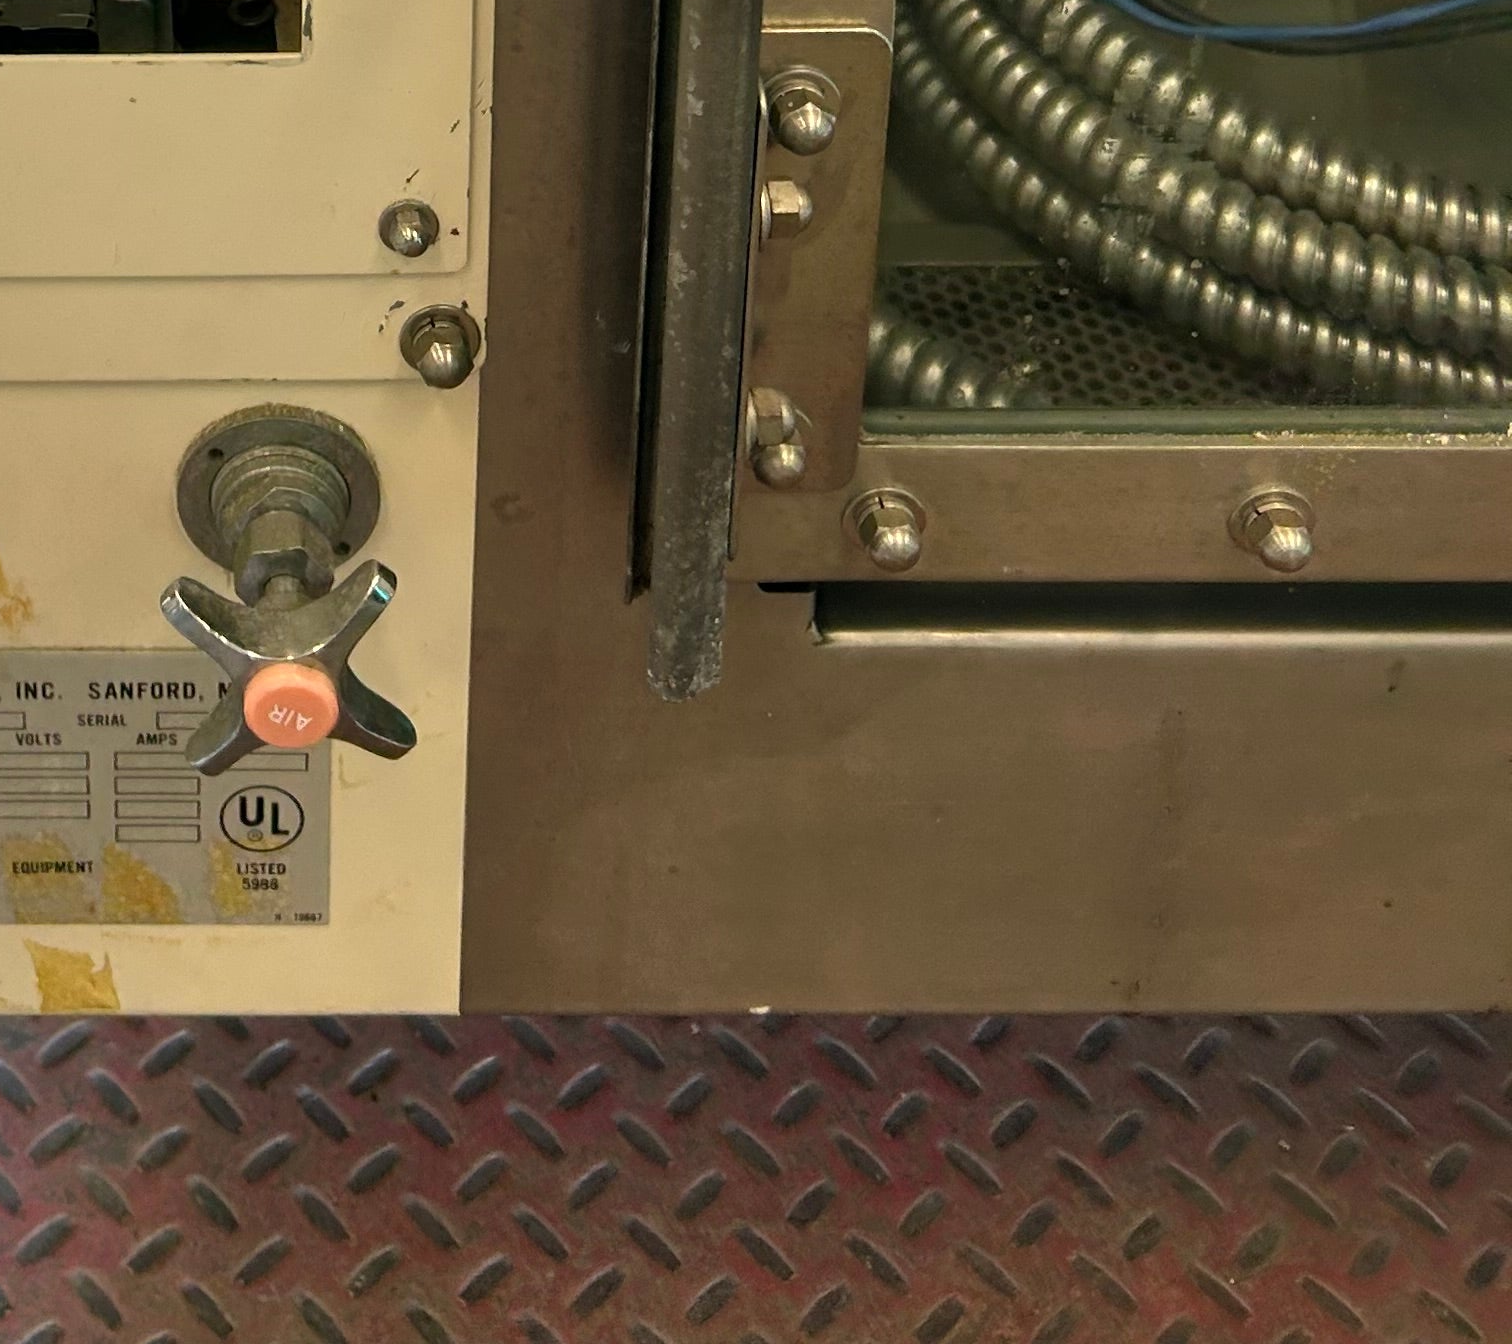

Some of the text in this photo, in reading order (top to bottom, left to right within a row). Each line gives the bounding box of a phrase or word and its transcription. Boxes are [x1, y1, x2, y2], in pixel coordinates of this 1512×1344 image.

[15, 681, 64, 702] INC.
[87, 680, 205, 705] SANFORD,
[76, 713, 128, 727] SERIAL
[267, 702, 314, 732] AIR
[15, 732, 63, 747] VOLTS
[135, 732, 179, 747] AMPS
[238, 795, 291, 836] UL
[11, 859, 95, 876] EQUIPMENT
[236, 862, 287, 876] LISTED
